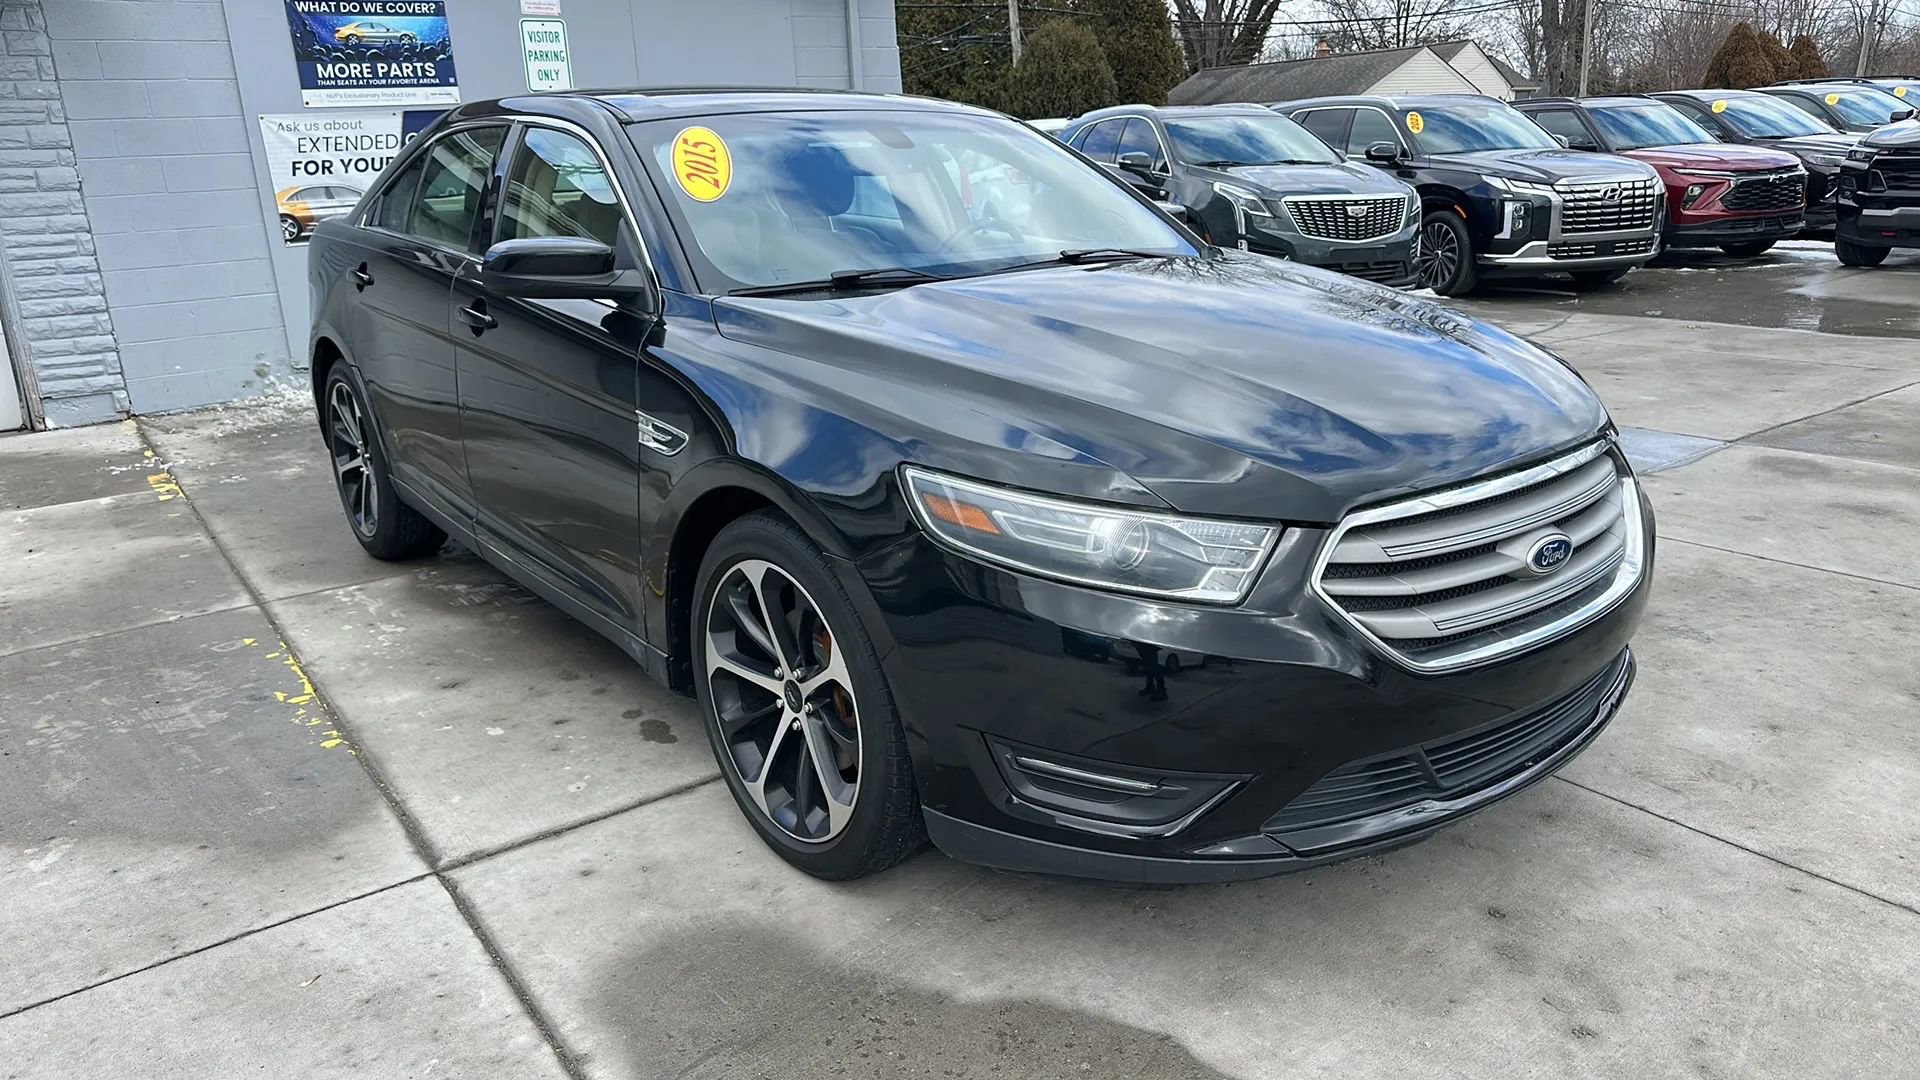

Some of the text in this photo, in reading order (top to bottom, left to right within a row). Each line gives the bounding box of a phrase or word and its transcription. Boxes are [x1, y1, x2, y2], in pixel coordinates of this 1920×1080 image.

[295, 2, 436, 14] WHAT DO WE COVER?
[527, 31, 560, 43] VISITOR
[528, 50, 565, 62] PARKING
[316, 62, 436, 78] MORE PARTS
[537, 69, 560, 81] ONLY
[277, 119, 363, 132] Ask us about
[297, 133, 399, 153] EXTENDED
[291, 159, 334, 177] FOR
[682, 137, 720, 189] 2015
[1541, 542, 1566, 566] Ford
